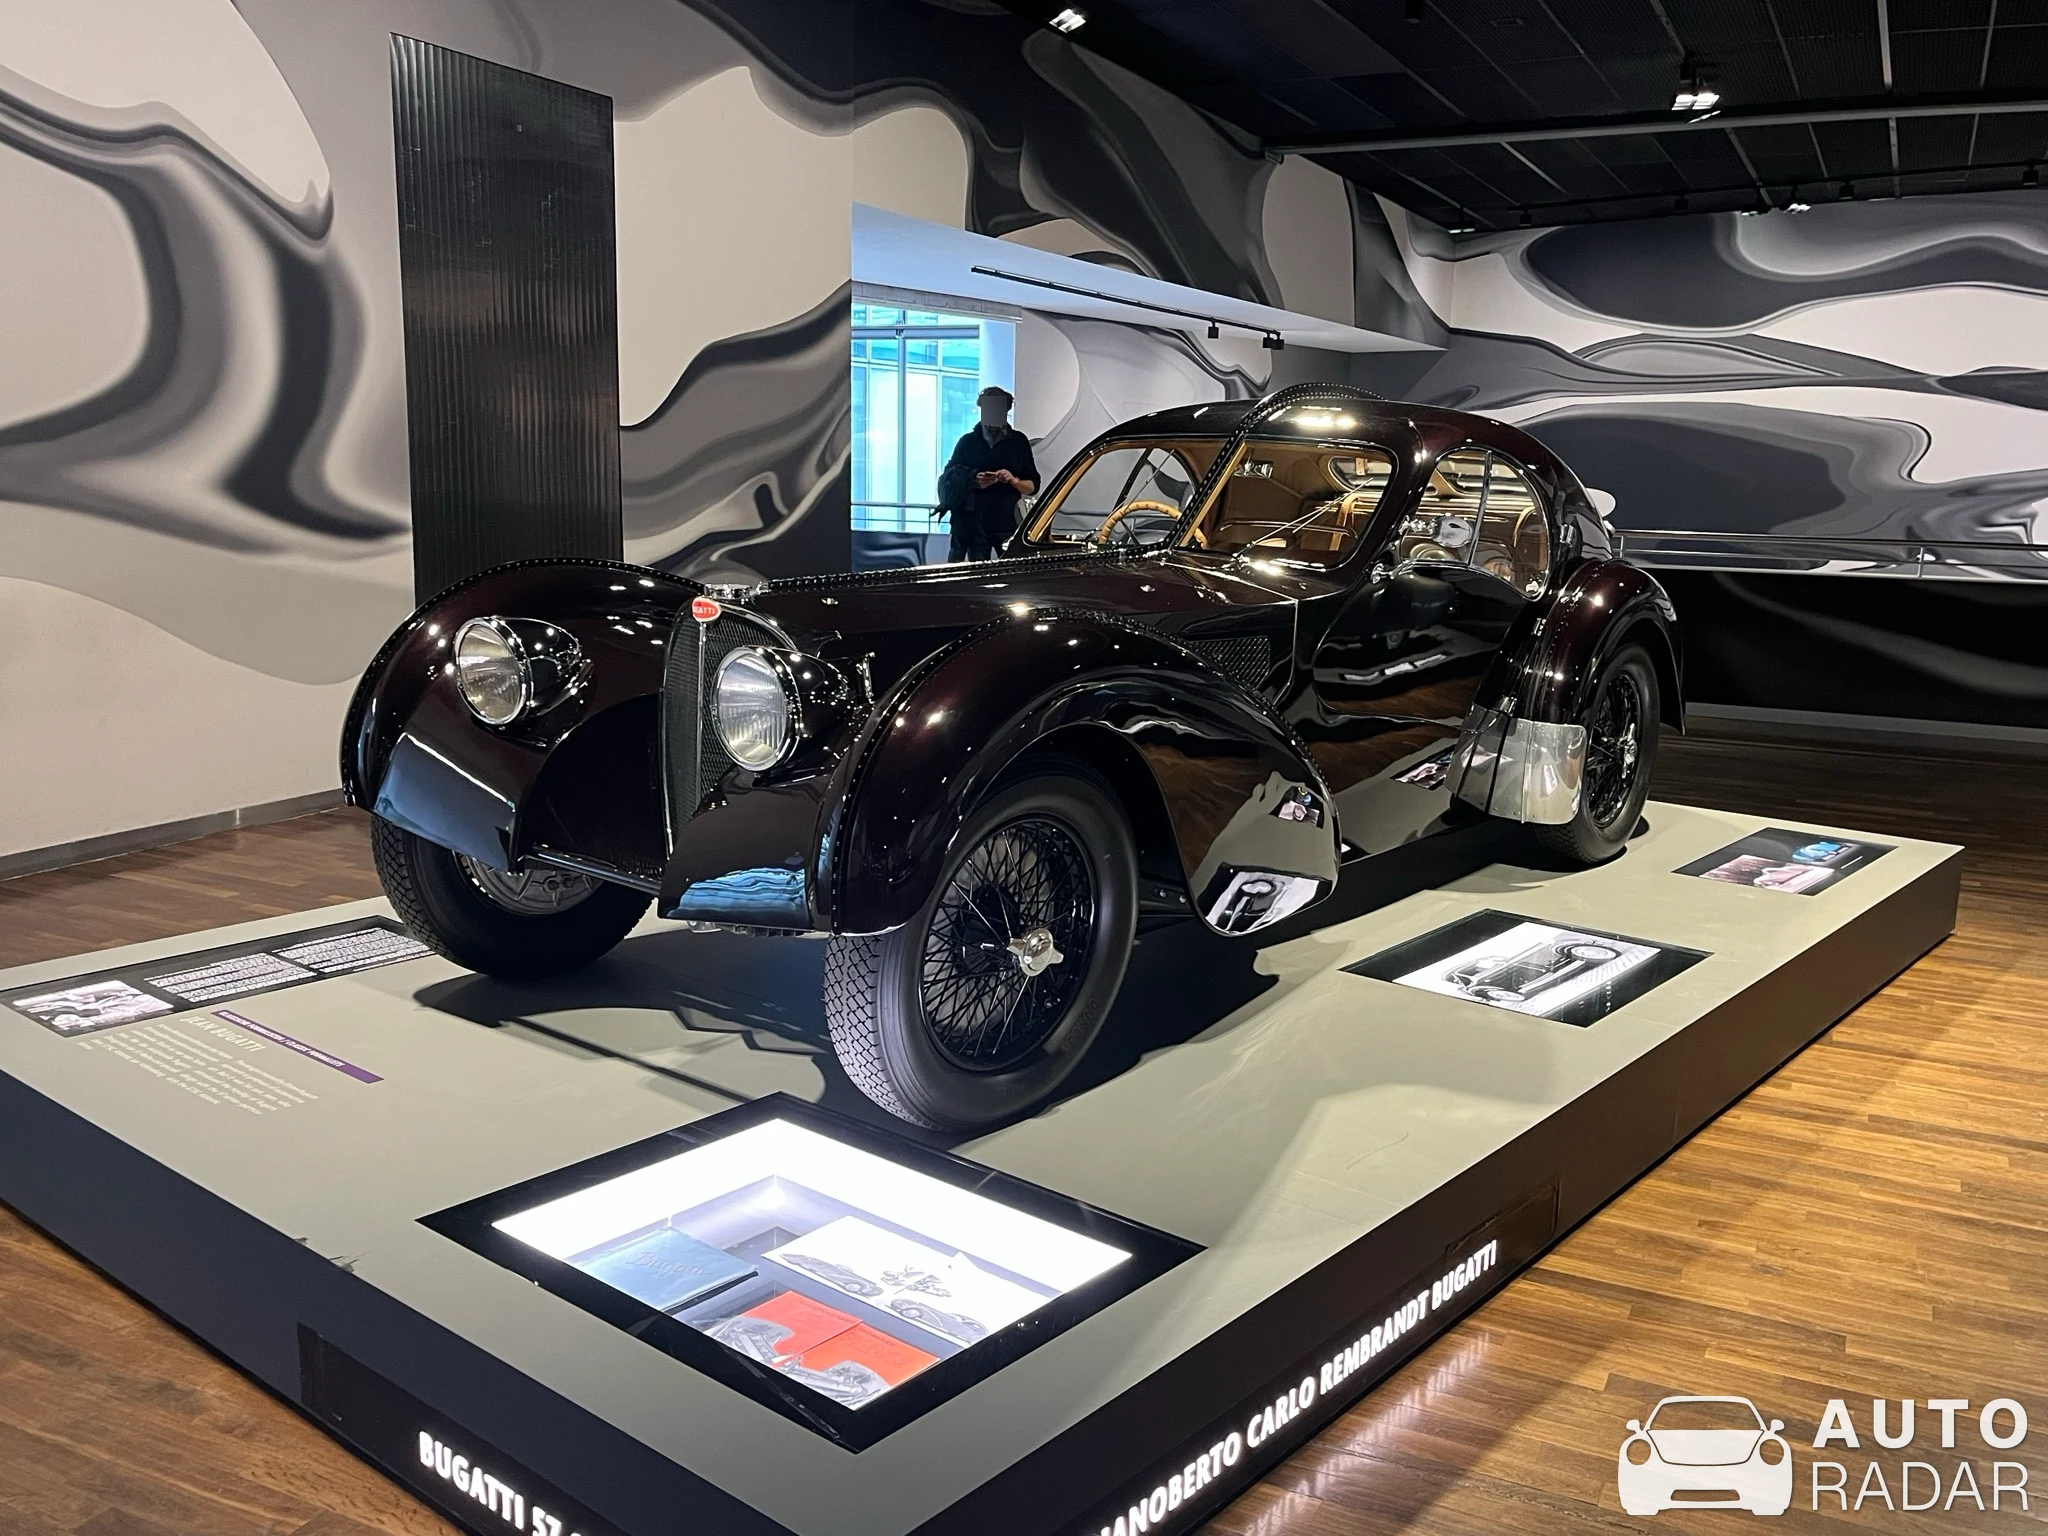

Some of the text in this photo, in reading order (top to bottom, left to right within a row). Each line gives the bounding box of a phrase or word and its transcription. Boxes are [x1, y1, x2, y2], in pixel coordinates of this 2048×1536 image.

[179, 1015, 213, 1030] JEAN
[210, 1026, 267, 1052] BUGATTI
[1247, 1377, 1316, 1447] CARLO
[1320, 1290, 1429, 1394] REMBRANDT
[1432, 1240, 1496, 1310] BUGATTI
[420, 1431, 561, 1536] BUGATTI 57
